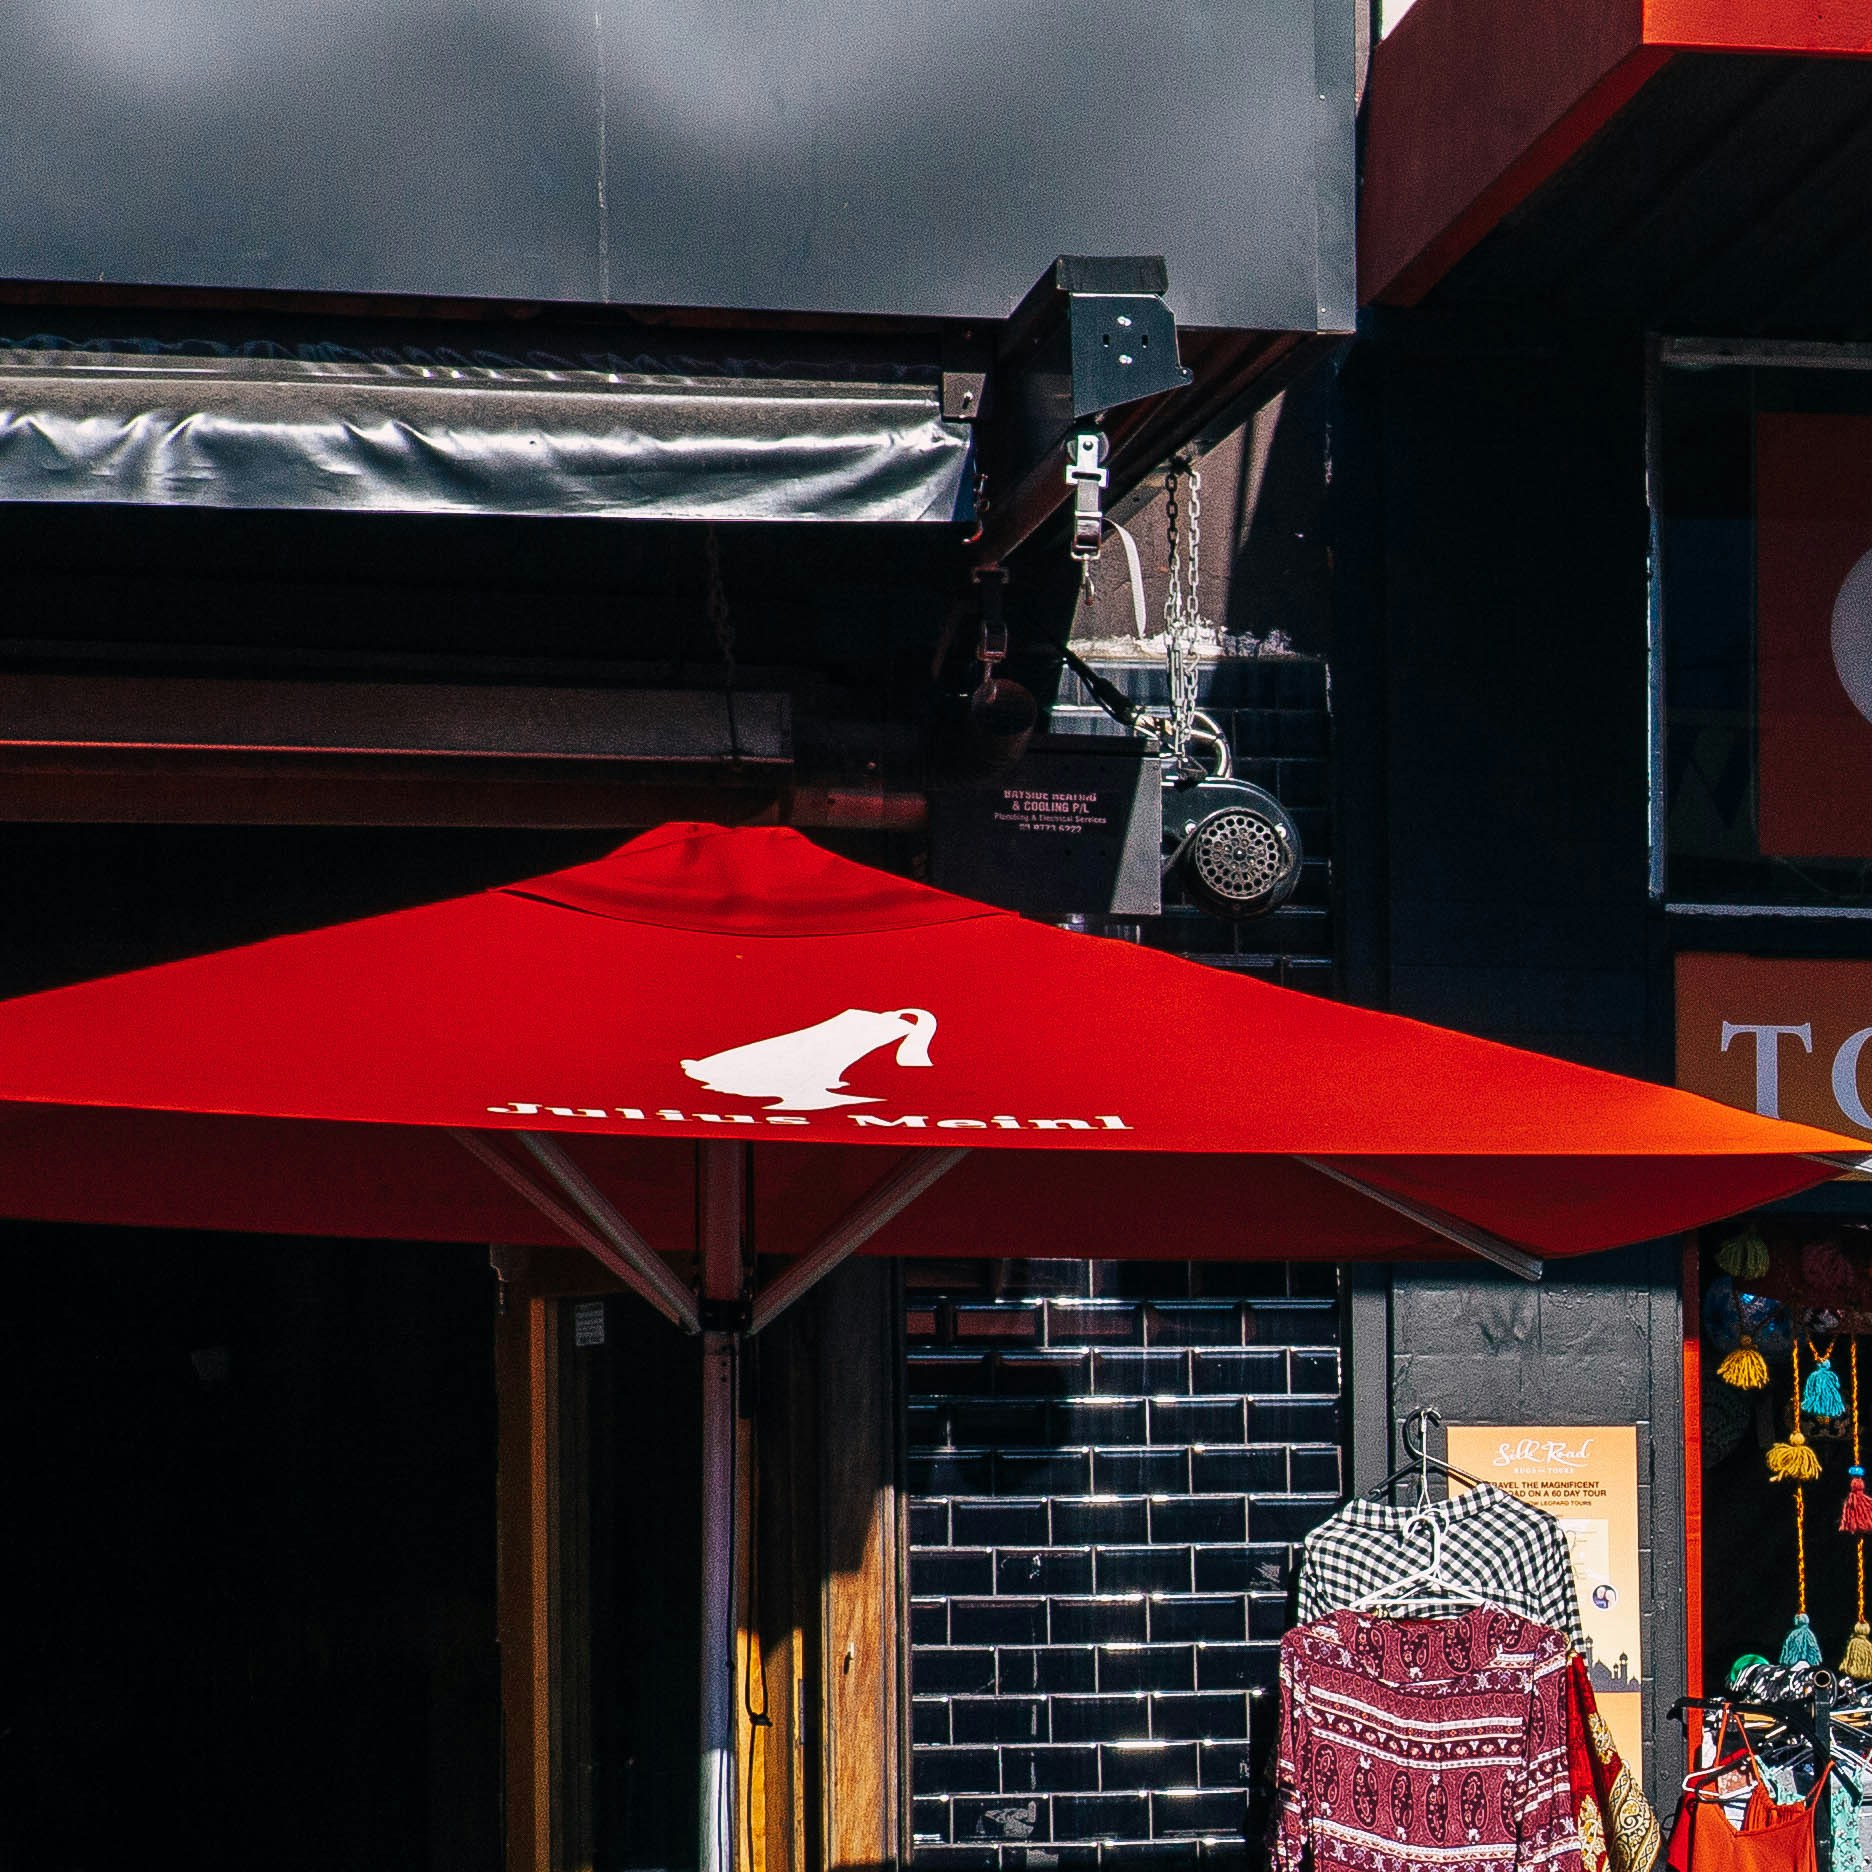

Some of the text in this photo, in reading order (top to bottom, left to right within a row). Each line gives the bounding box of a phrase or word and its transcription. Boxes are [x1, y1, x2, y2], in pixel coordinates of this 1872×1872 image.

[1023, 801, 1069, 813] COOLING
[1072, 803, 1089, 814] P/L
[485, 1101, 1135, 1132] Julius Meinl
[1492, 1438, 1595, 1467] Silk Road
[1541, 1481, 1599, 1489] MAGNIFICENT
